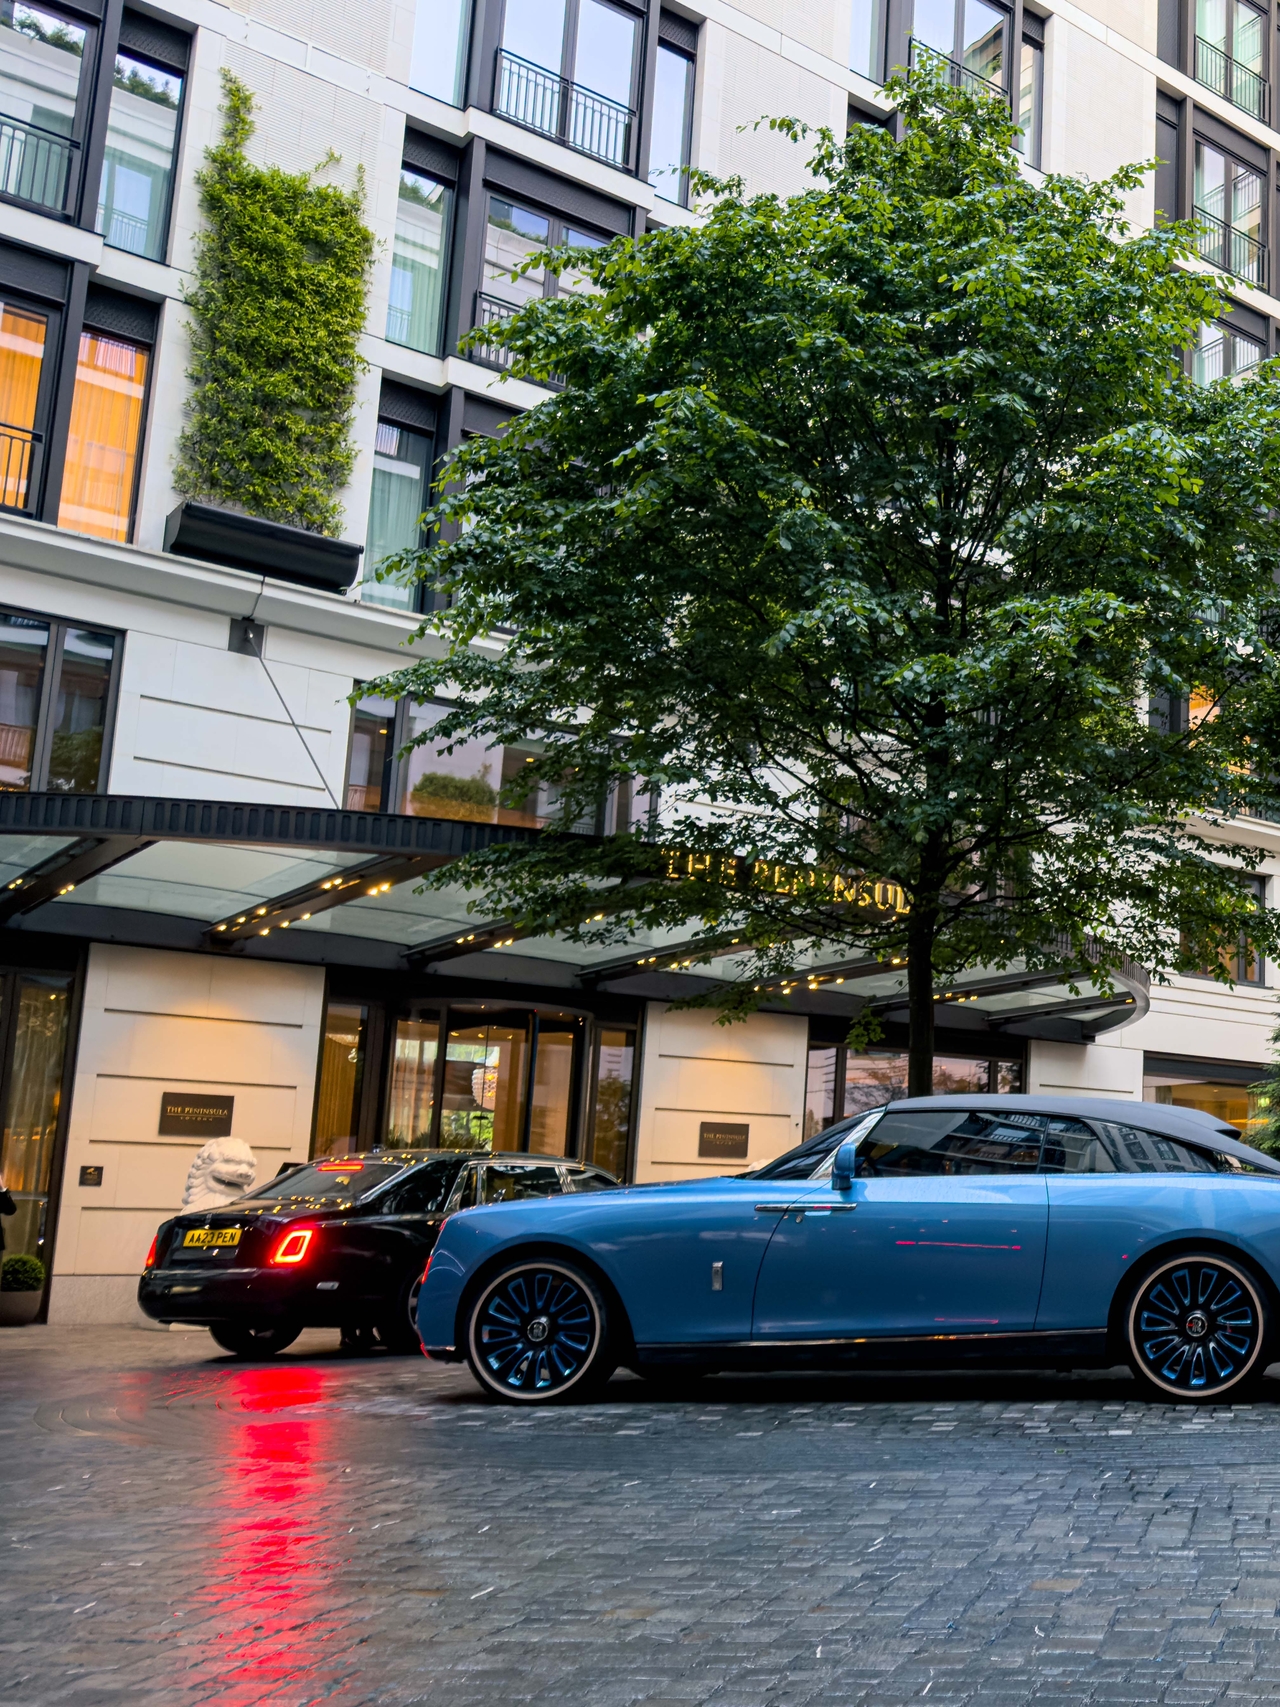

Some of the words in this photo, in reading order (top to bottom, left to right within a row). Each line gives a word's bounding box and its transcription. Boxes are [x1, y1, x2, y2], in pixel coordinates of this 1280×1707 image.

[166, 1106, 181, 1114] THE
[184, 1107, 228, 1116] PENINSULA
[188, 1232, 214, 1244] AA23
[215, 1232, 237, 1244] PEN
